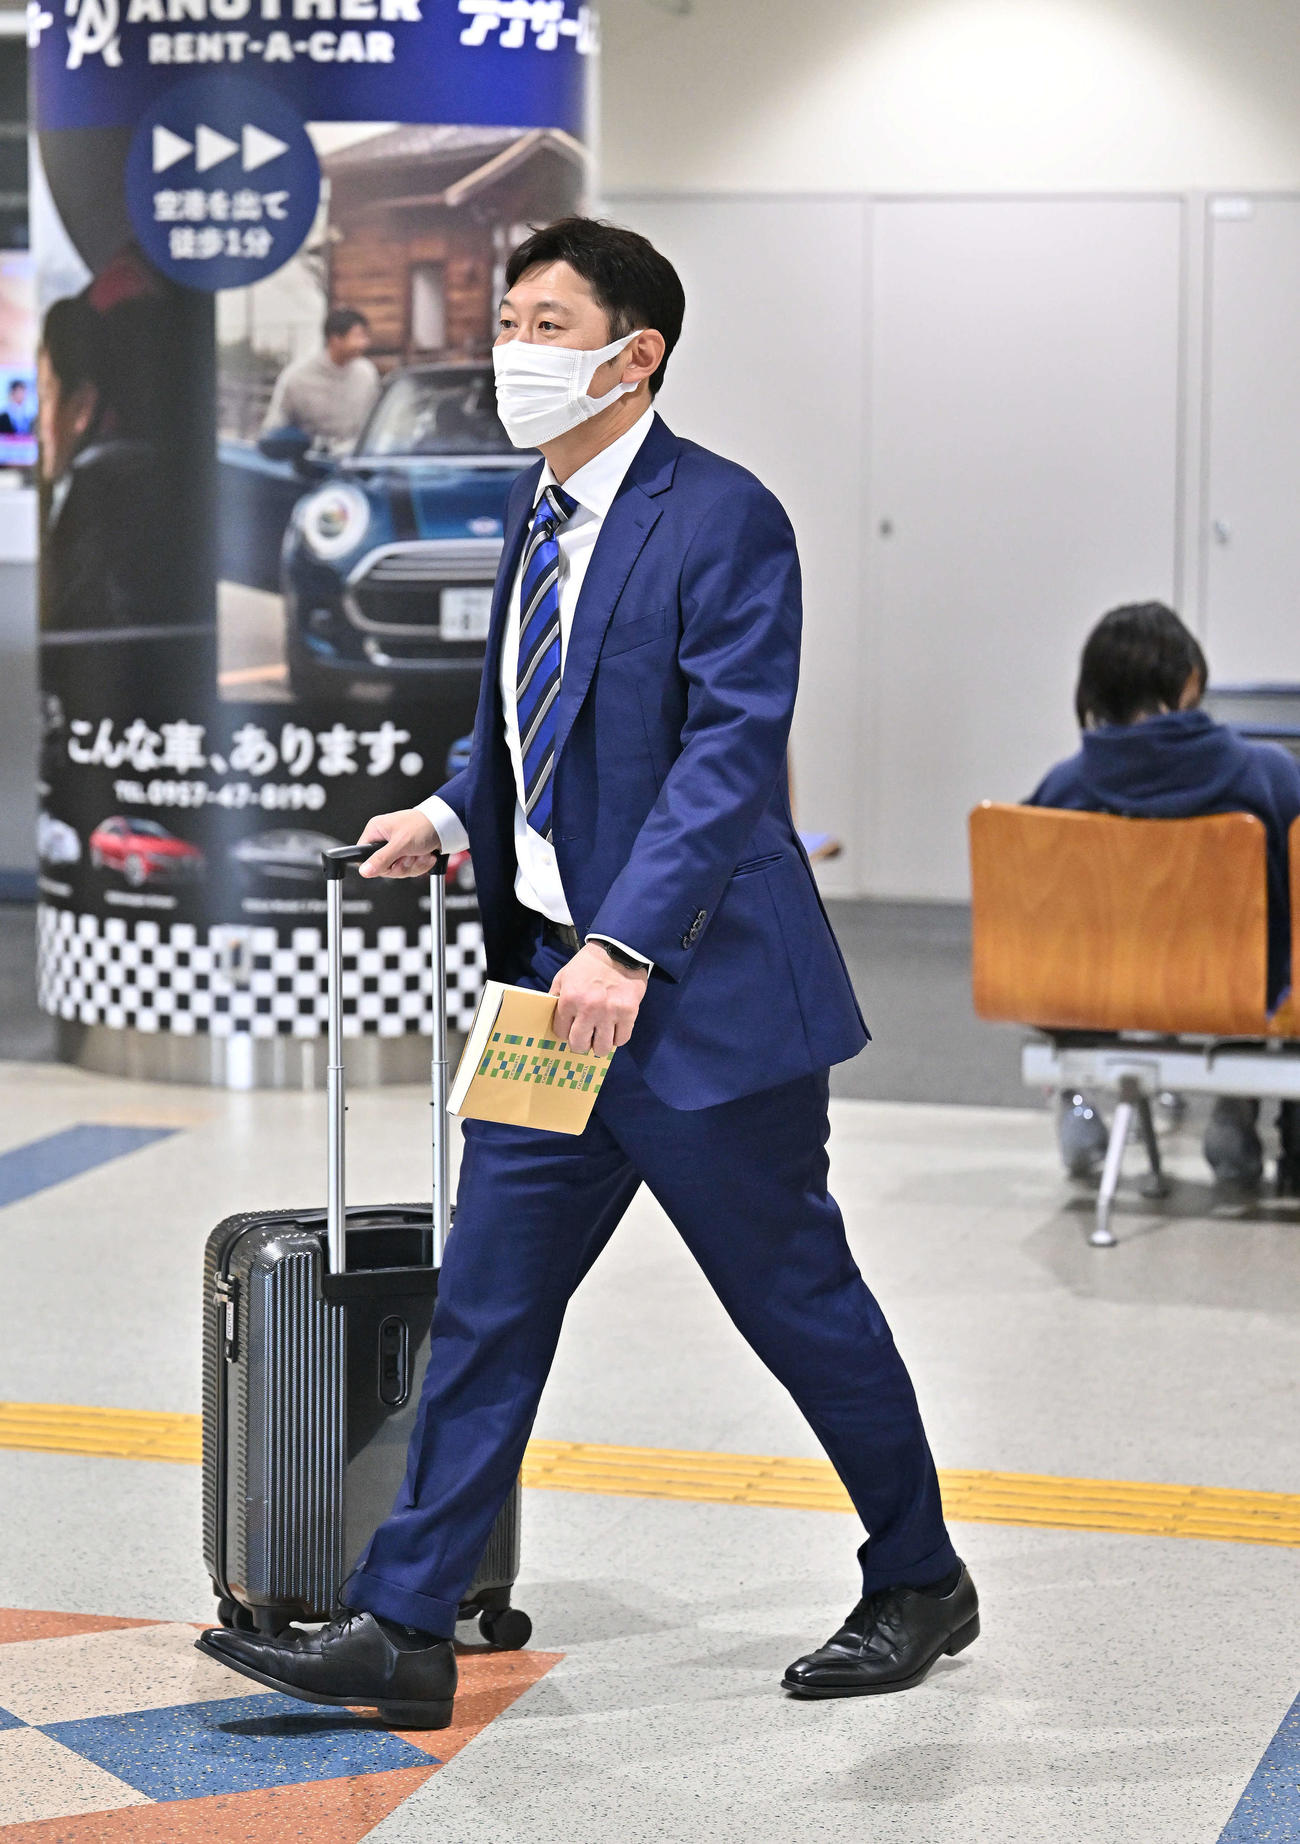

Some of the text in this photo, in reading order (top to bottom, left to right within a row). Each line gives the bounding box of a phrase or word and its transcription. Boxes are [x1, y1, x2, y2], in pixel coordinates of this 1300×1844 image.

[148, 31, 395, 64] RENT-A-CAR
[153, 188, 291, 222] 空港を出て
[168, 226, 275, 260] 徒歩1分
[68, 717, 423, 776] こんな車、あります。
